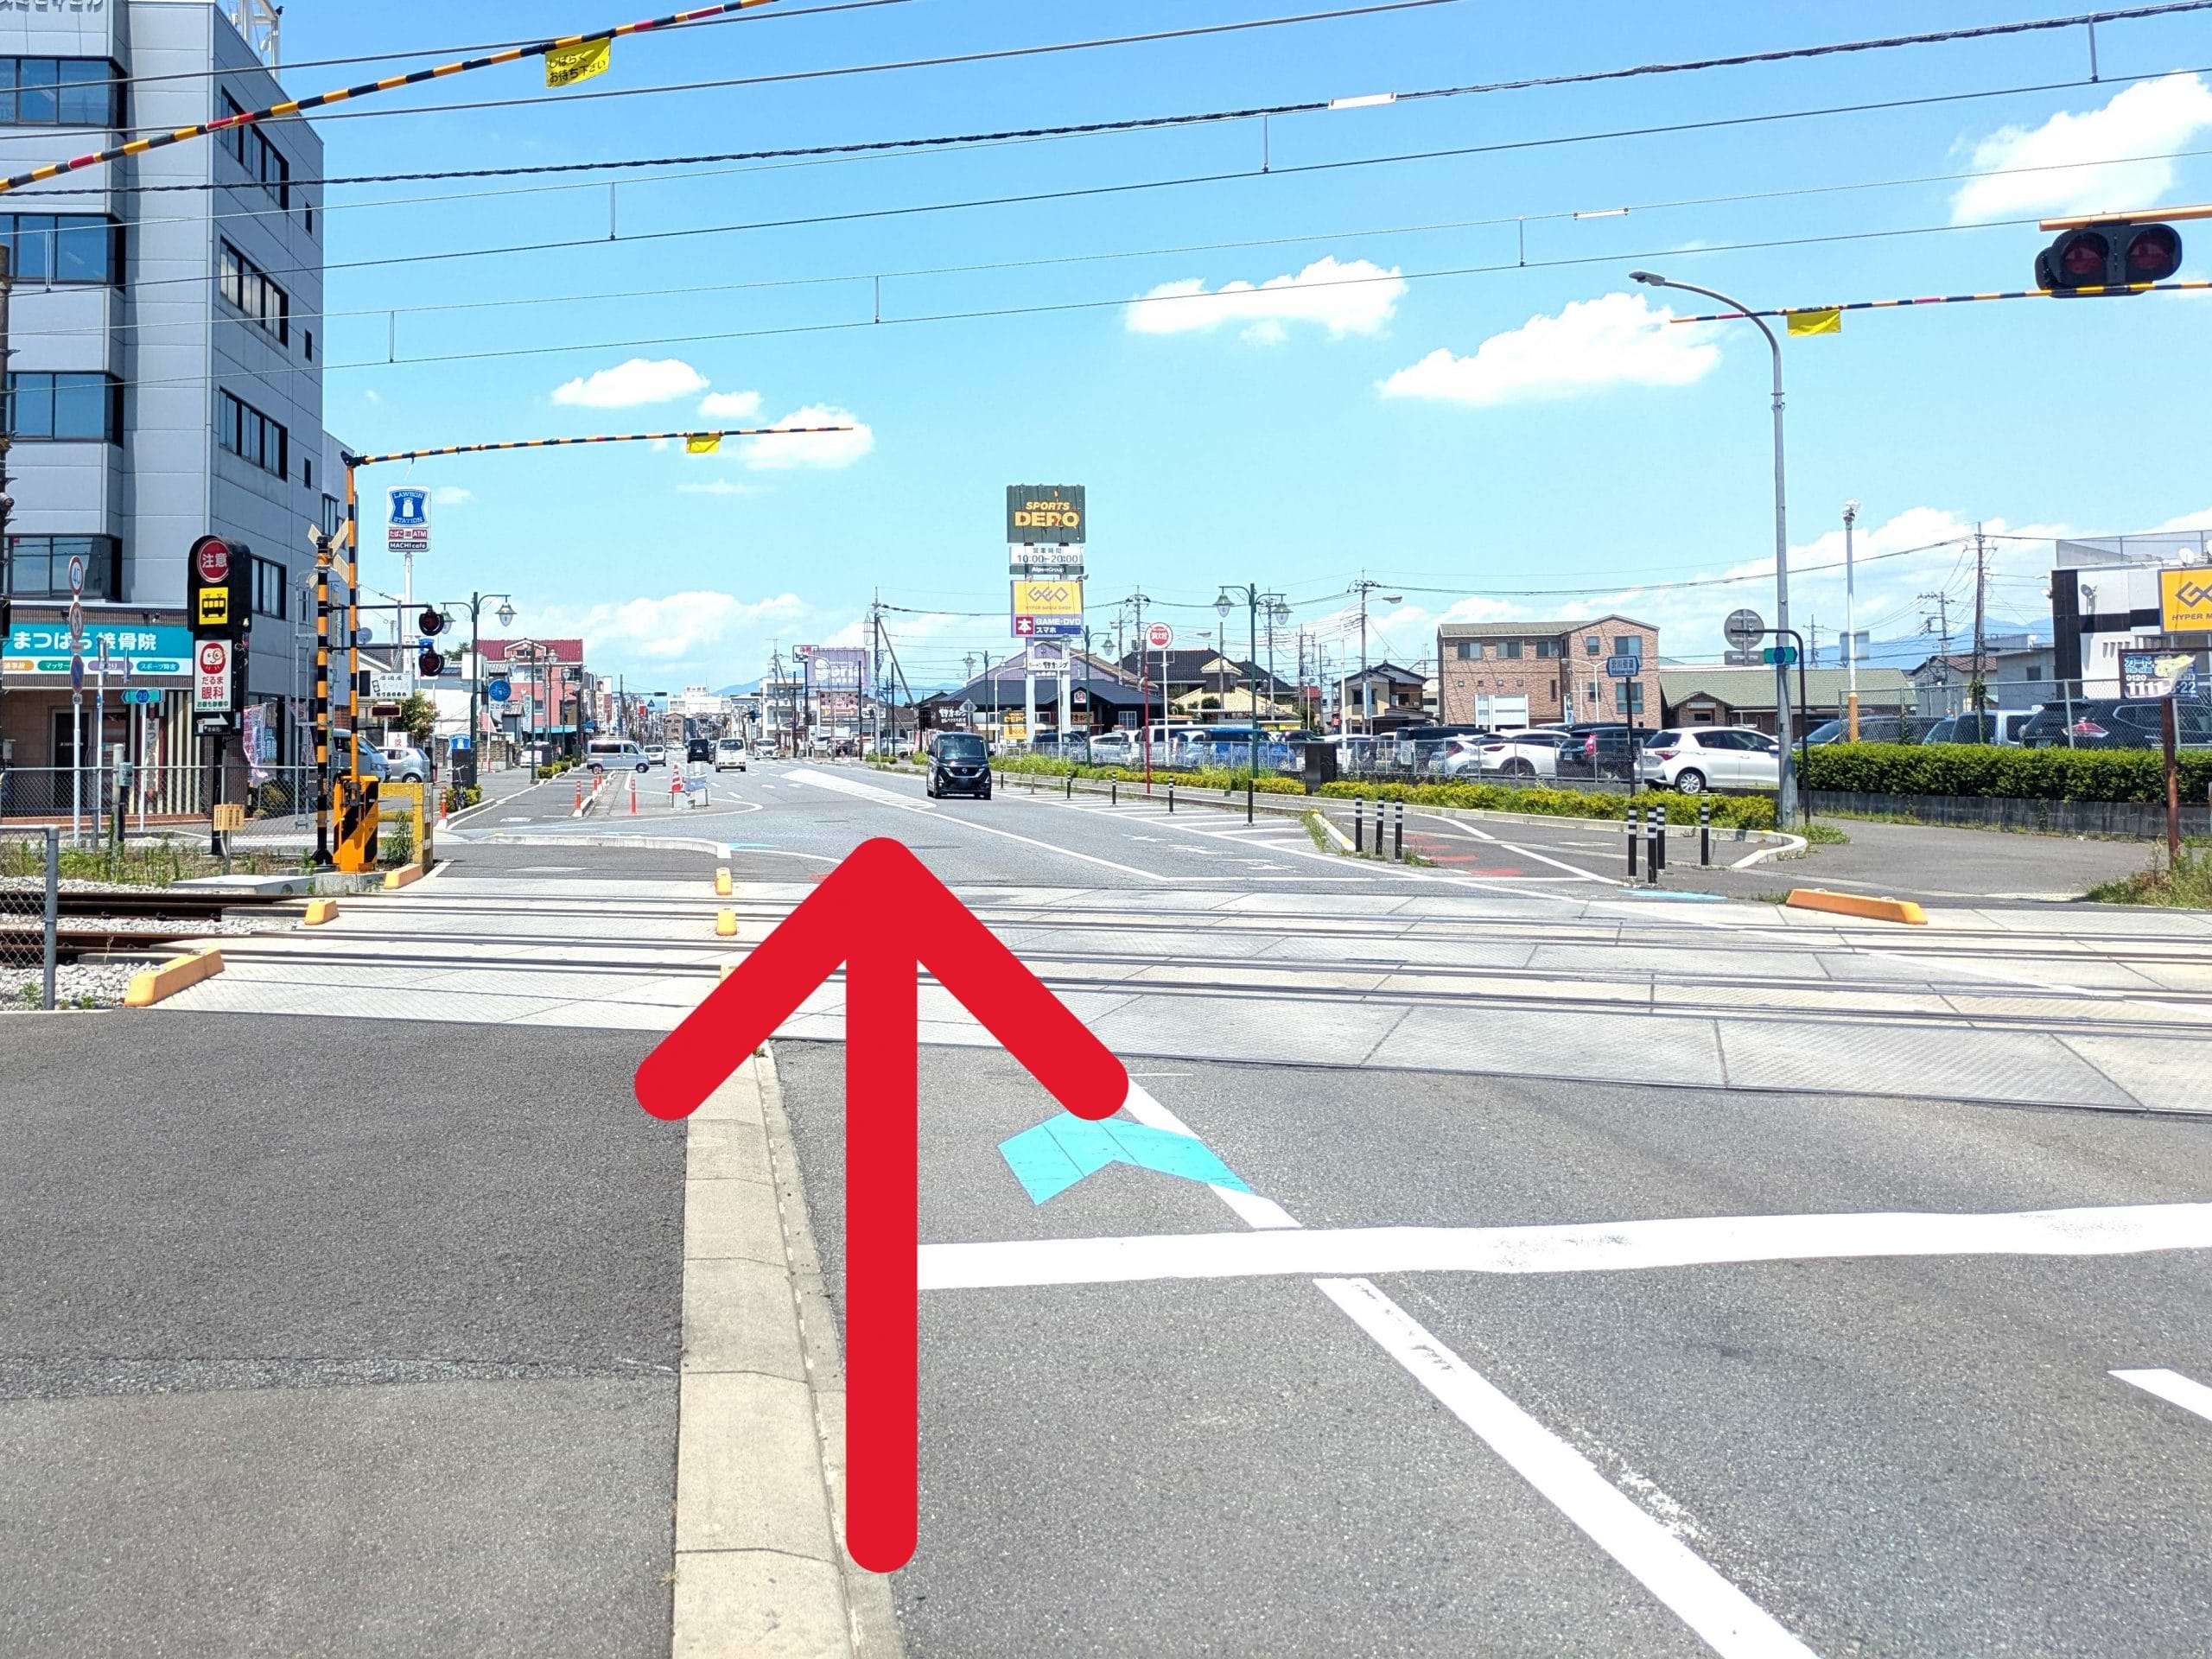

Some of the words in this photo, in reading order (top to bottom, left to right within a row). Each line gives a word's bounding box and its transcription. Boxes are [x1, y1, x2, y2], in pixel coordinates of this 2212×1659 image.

[549, 54, 588, 69] しばらく
[550, 60, 606, 83] お待ち下さい
[1026, 501, 1071, 511] SPORTS
[201, 553, 228, 568] 注意
[73, 569, 81, 584] 40
[1027, 586, 1070, 603] GEO
[2171, 613, 2203, 621] HYPER
[1017, 618, 1033, 633] 本
[45, 662, 72, 671] マッサー
[139, 663, 176, 671] スポーツ障害
[201, 676, 225, 685] だるま
[138, 692, 148, 701] 29
[201, 686, 225, 700] 眼科
